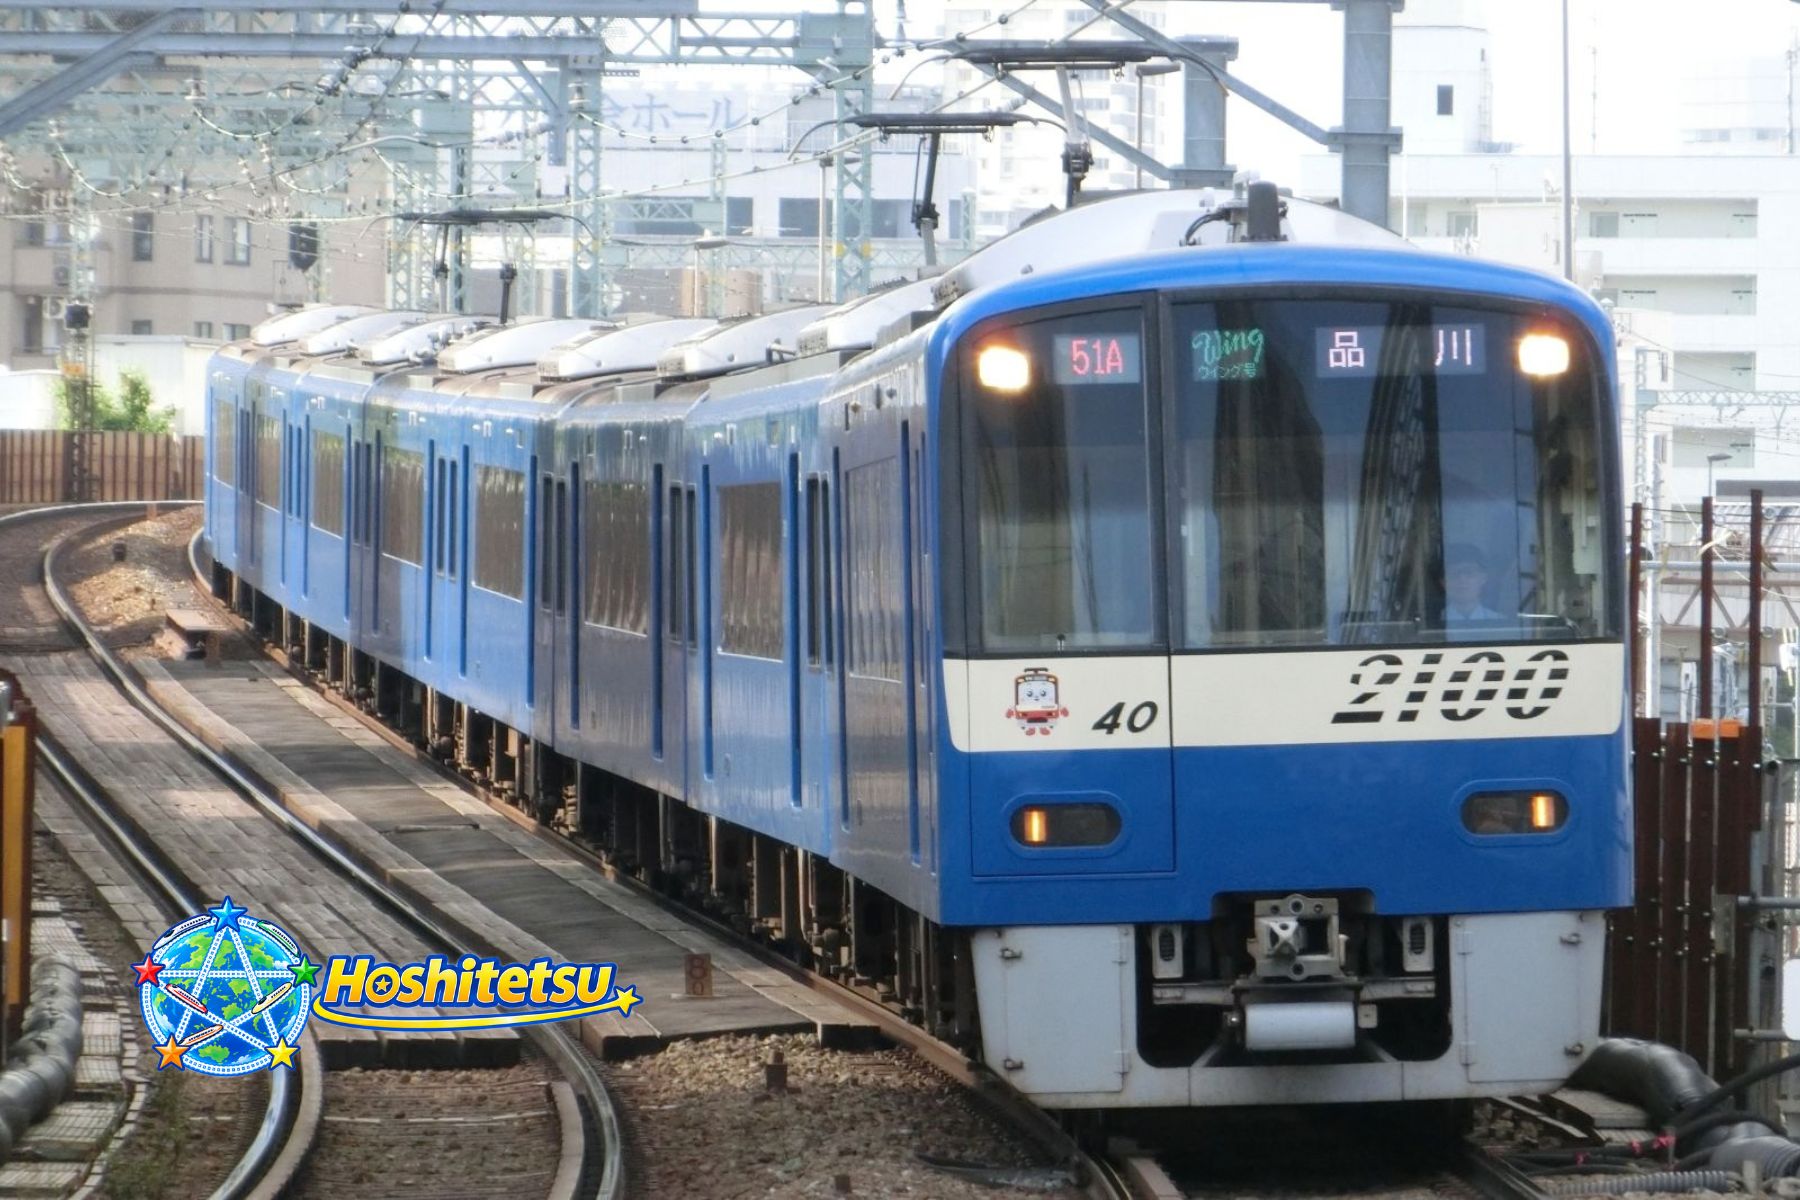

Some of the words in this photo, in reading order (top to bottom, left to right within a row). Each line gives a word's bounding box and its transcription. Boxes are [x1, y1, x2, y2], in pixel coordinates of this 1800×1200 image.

[1071, 337, 1124, 375] 51A
[1192, 328, 1264, 366] Wing
[1329, 329, 1472, 367] 品川
[1331, 650, 1569, 723] 2100
[1091, 700, 1158, 735] 40
